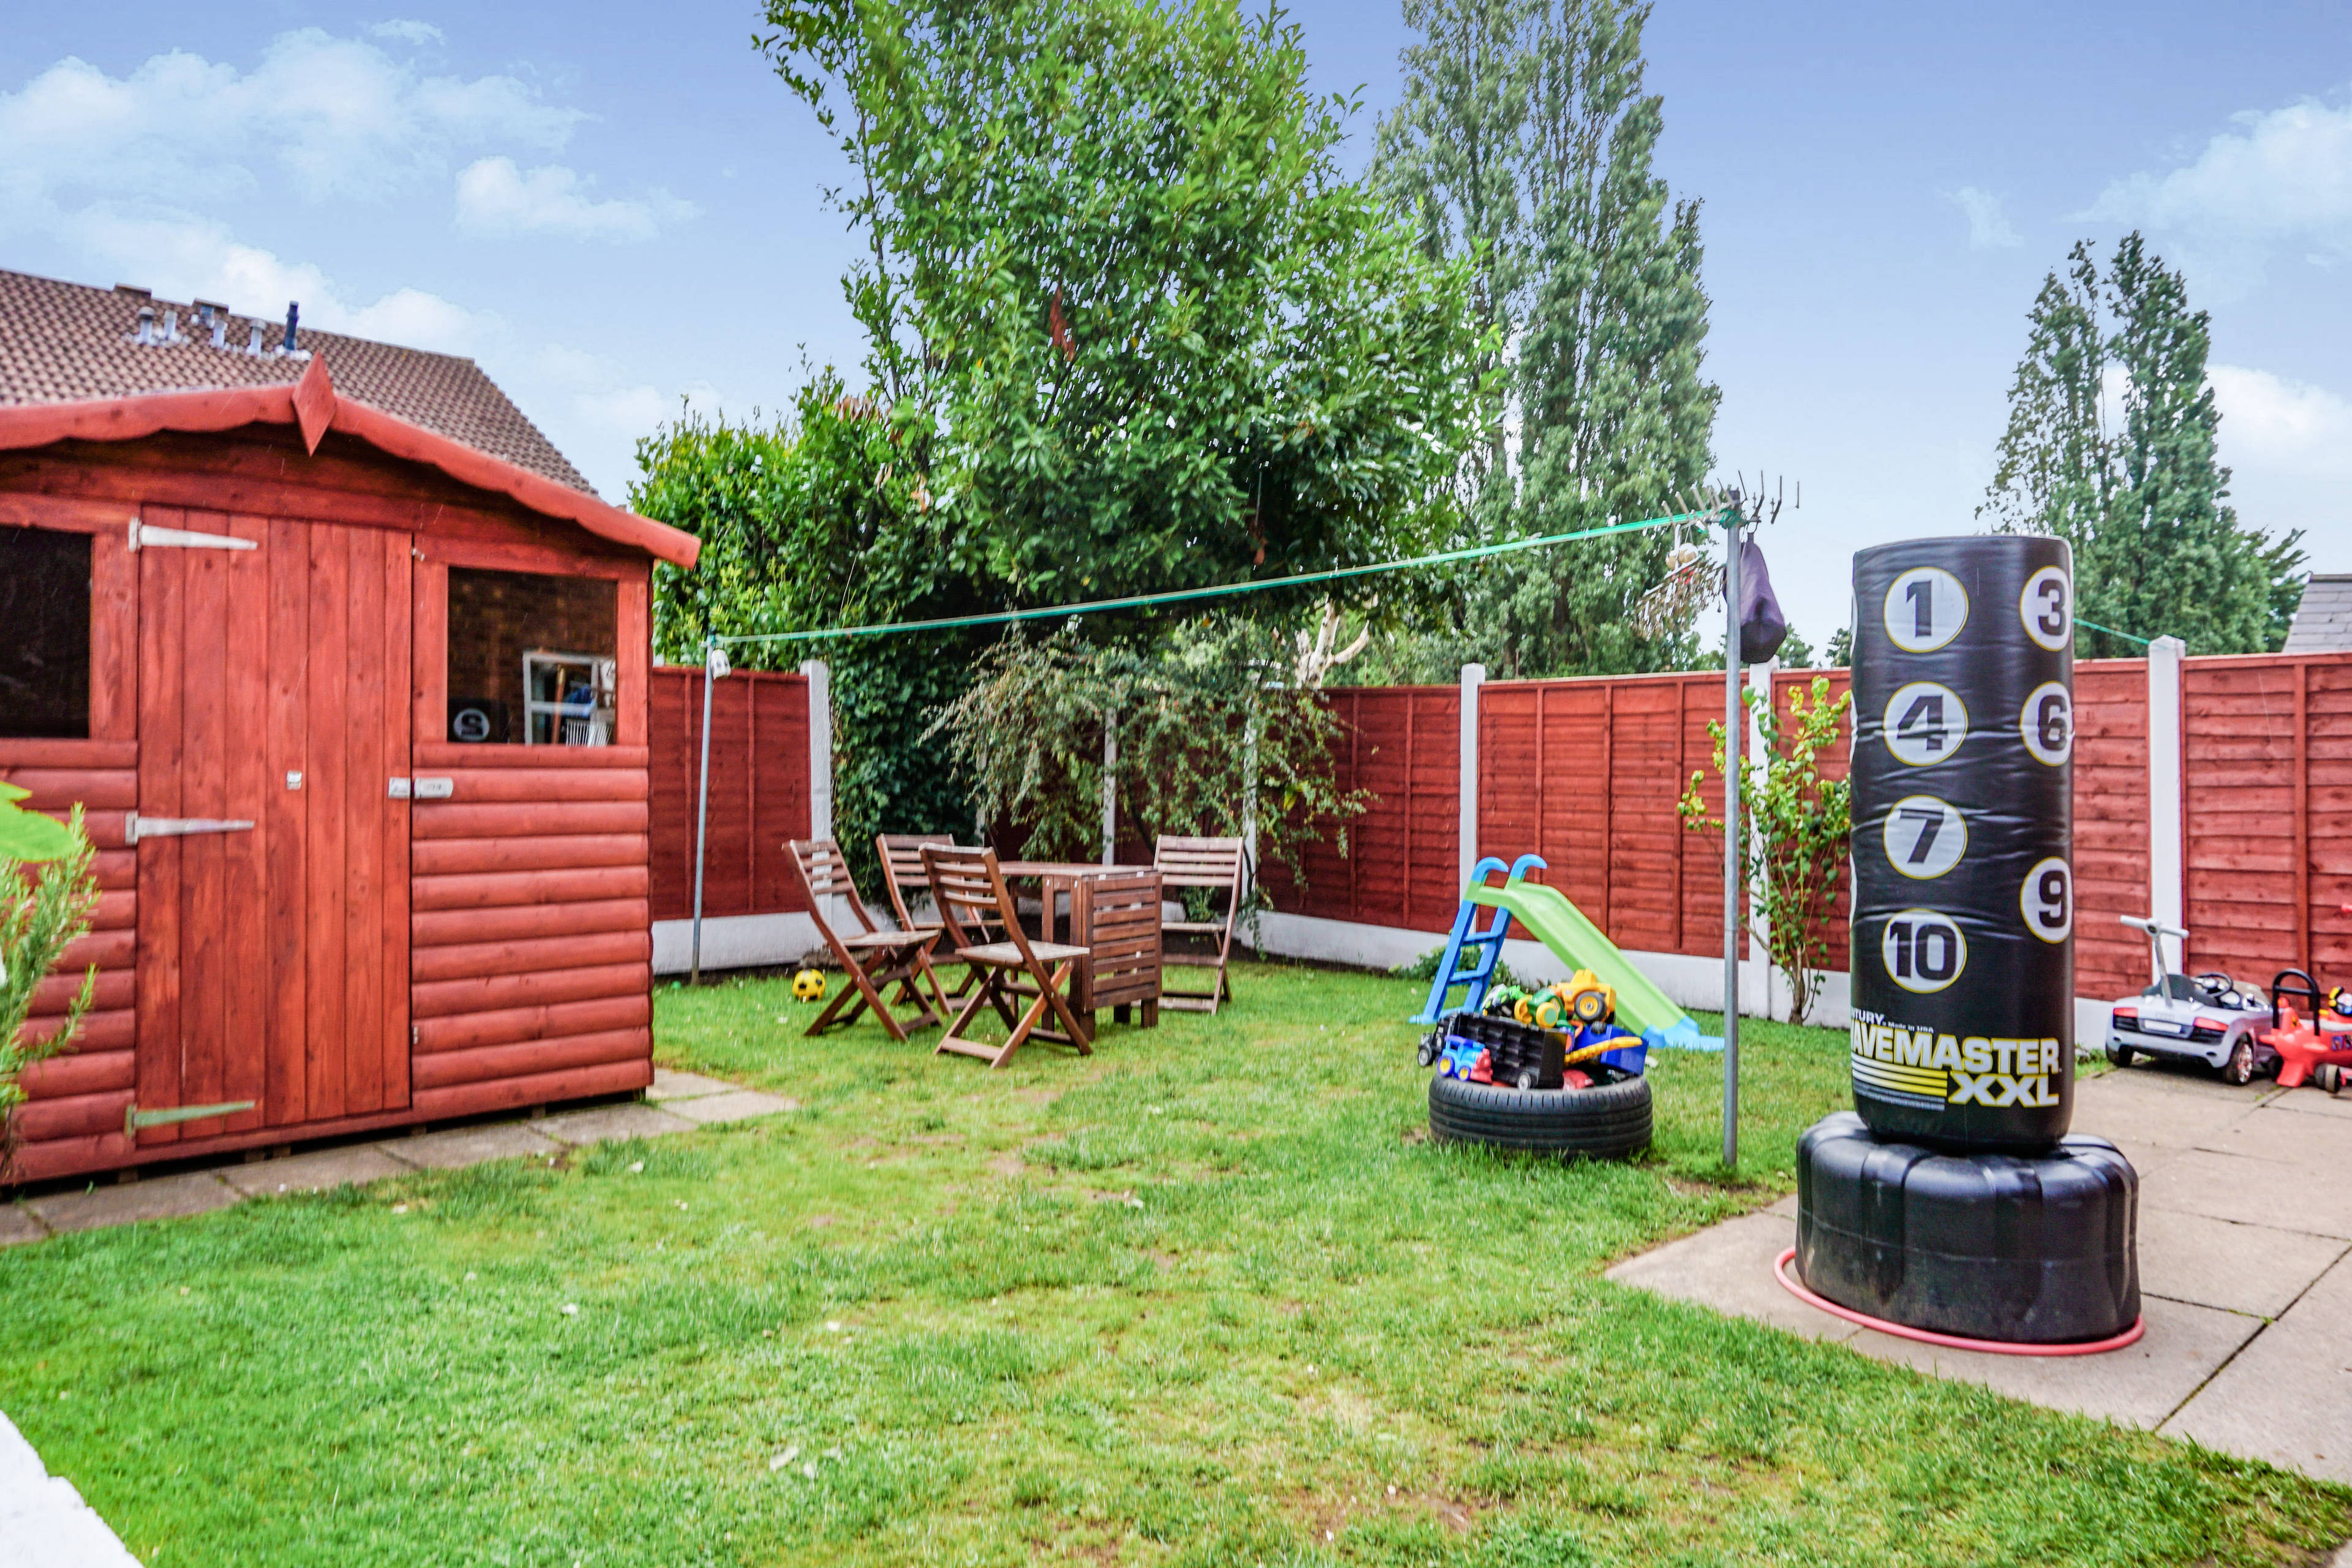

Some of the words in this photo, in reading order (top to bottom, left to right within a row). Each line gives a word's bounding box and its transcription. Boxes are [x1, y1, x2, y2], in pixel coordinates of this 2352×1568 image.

[1906, 579, 1932, 638] 1
[2038, 579, 2067, 637] 3
[1897, 694, 1948, 751] 4
[2038, 695, 2067, 752] 6
[1899, 808, 1945, 865] 7
[2039, 870, 2067, 928] 9
[1889, 921, 1957, 981] 10
[1851, 1017, 2060, 1075] AVEMASTER
[1948, 1073, 2059, 1108] XXL
